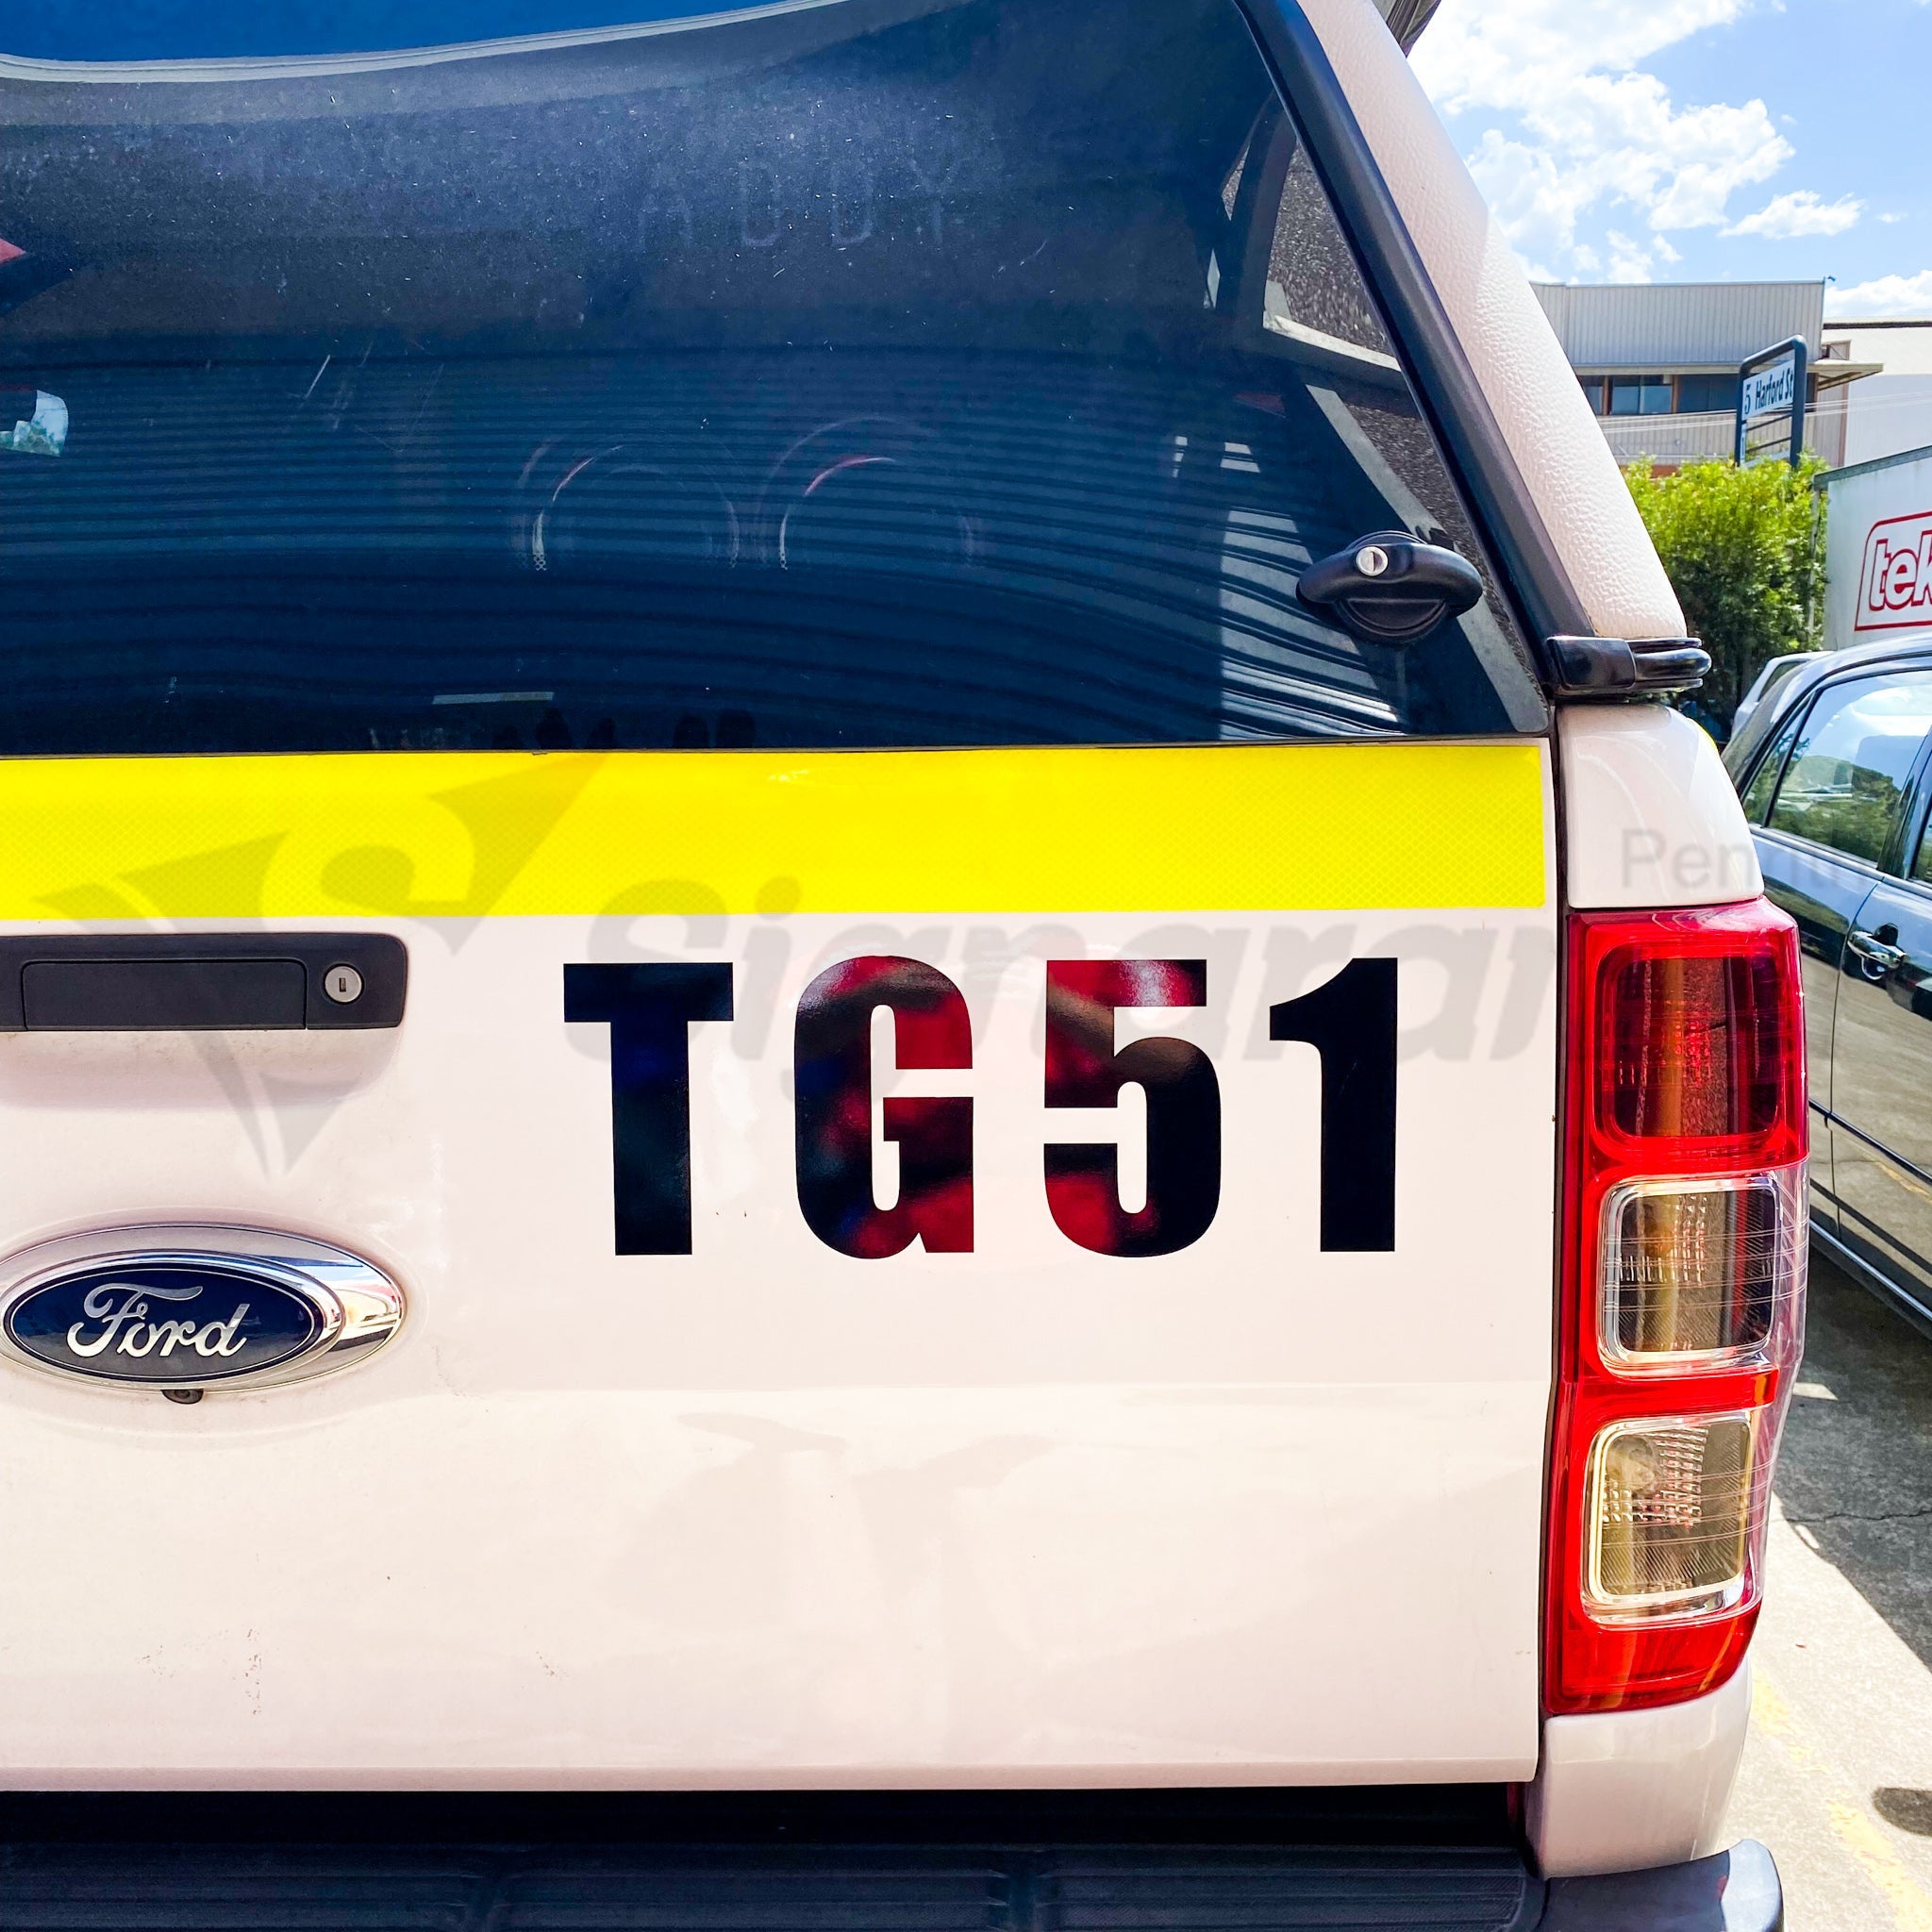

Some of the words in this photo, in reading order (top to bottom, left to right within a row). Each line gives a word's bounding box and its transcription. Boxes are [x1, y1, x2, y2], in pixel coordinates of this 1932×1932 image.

[1744, 384, 1752, 415] 5
[1755, 370, 1785, 410] Harford
[562, 955, 1398, 1260] TG51
[66, 1282, 250, 1357] Ford
